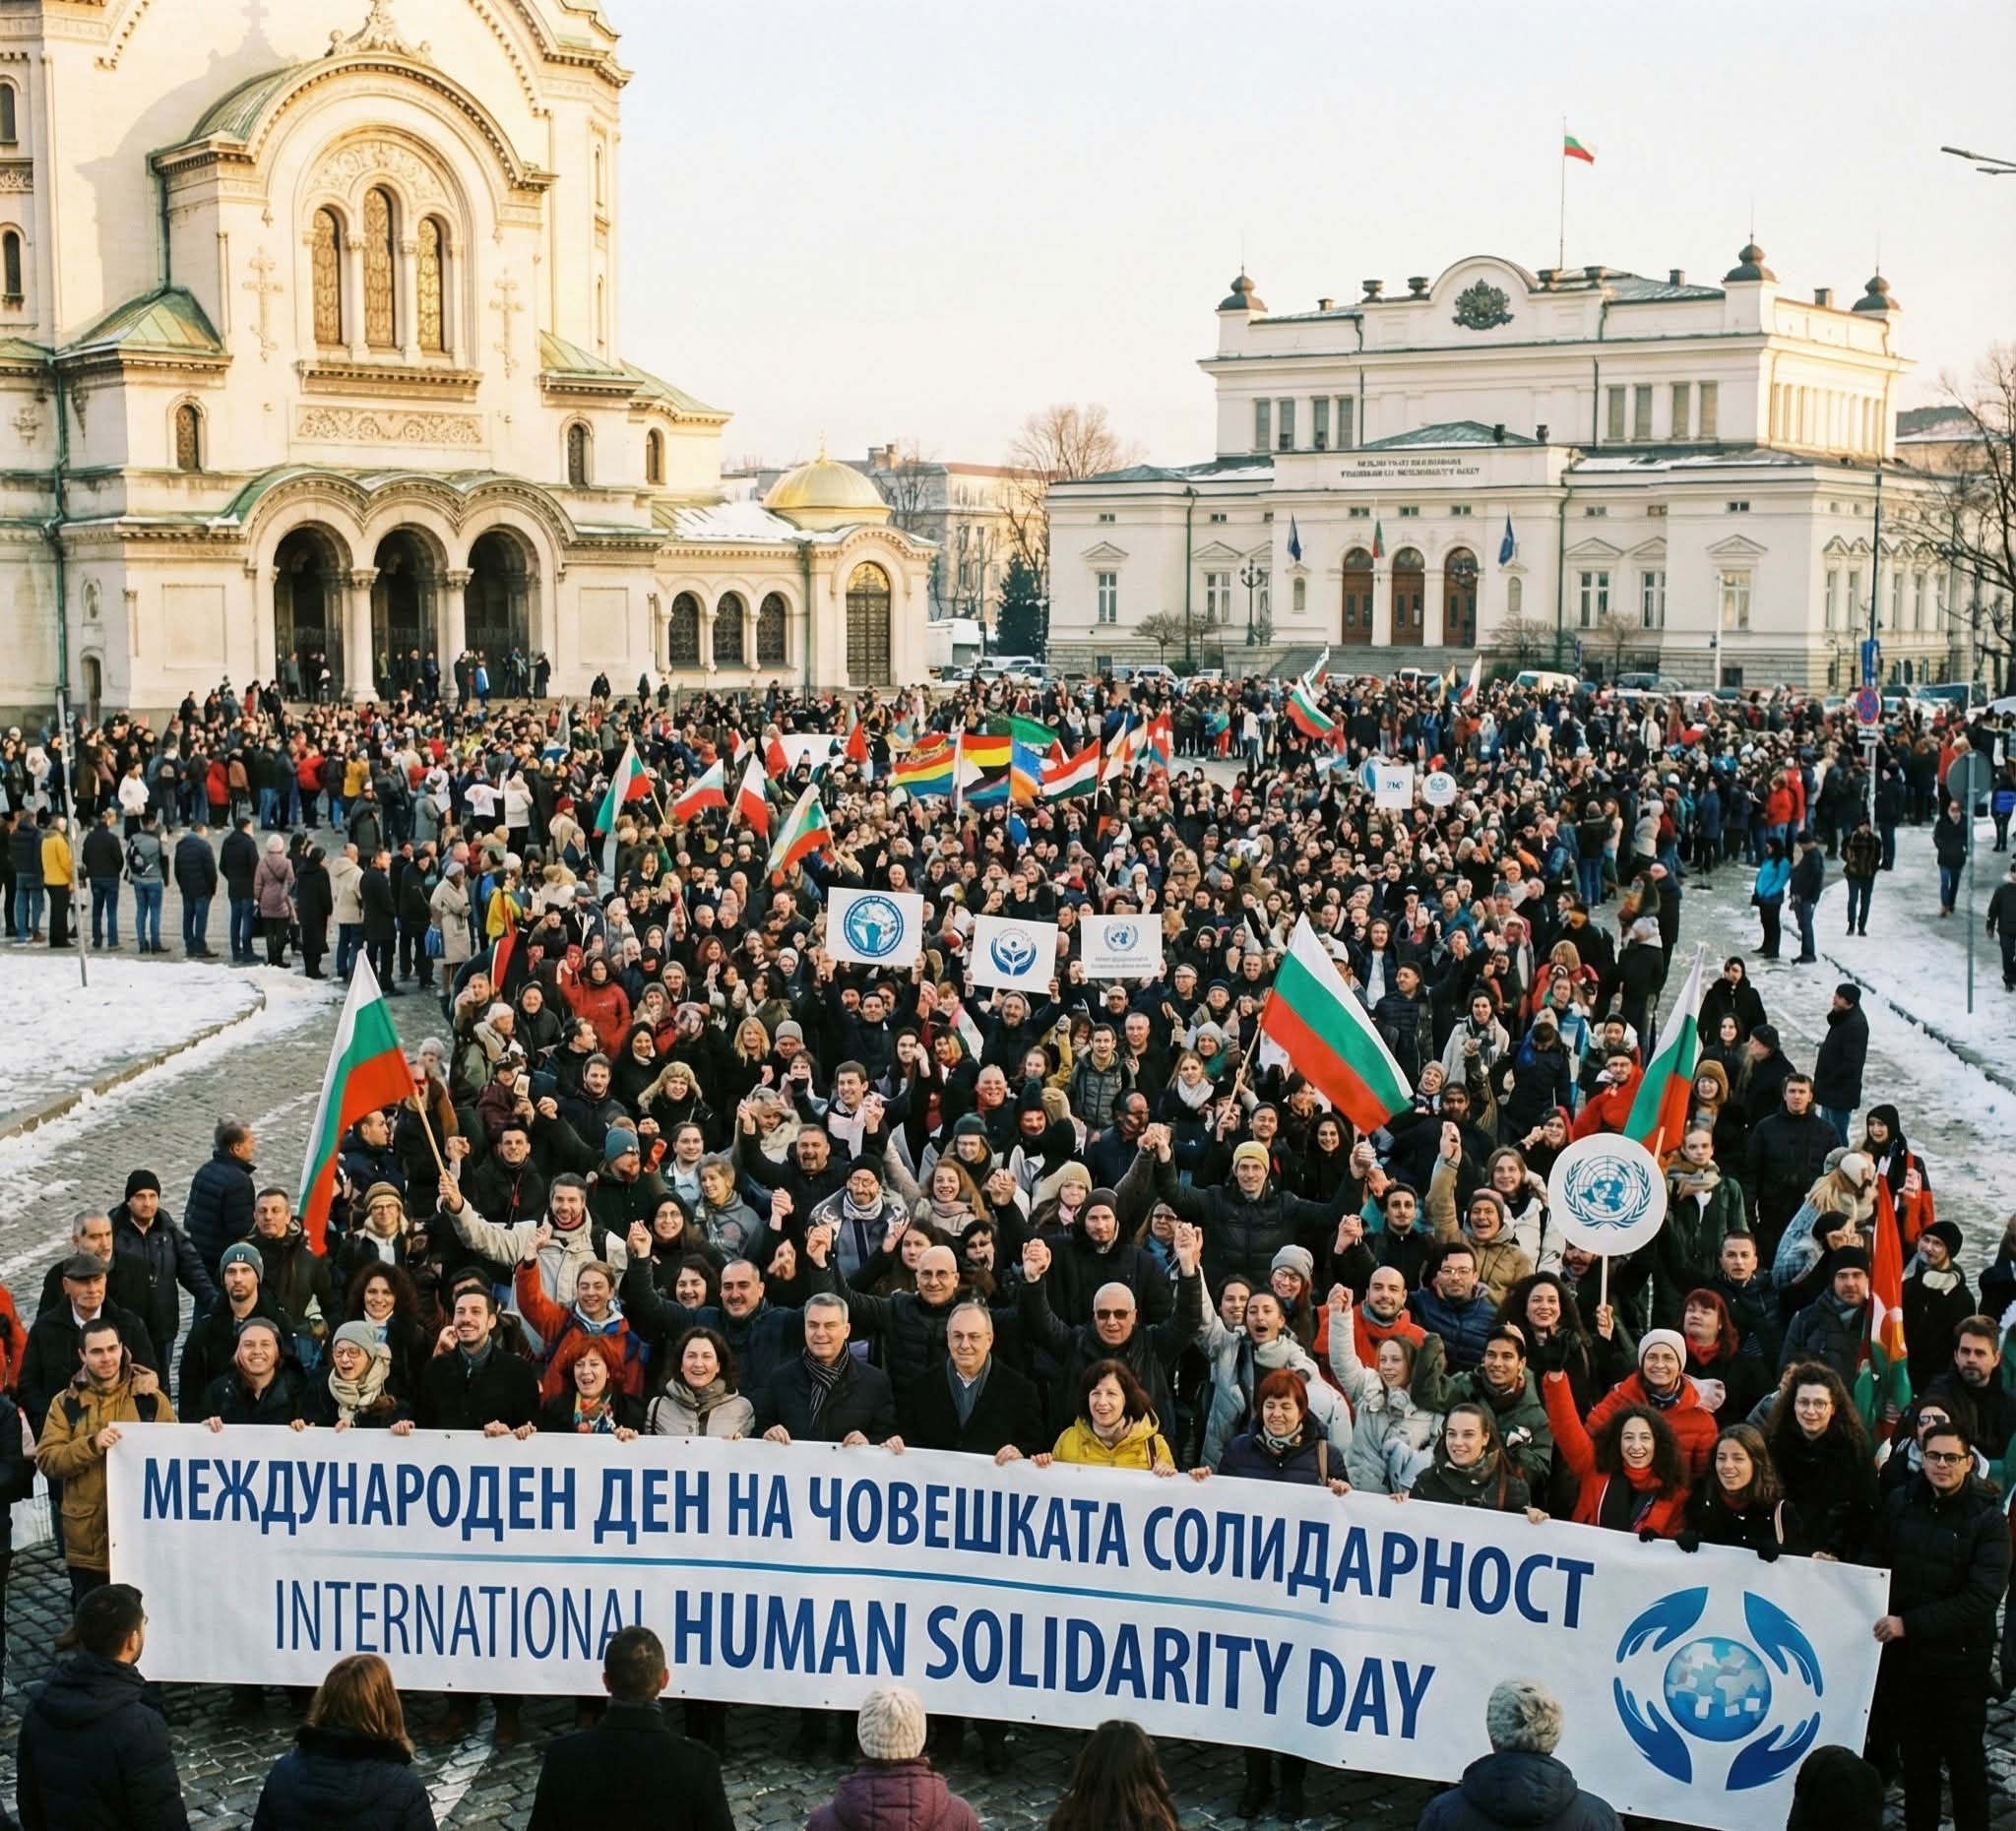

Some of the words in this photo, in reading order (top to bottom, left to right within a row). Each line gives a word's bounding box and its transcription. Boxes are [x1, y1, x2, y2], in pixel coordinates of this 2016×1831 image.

[143, 1457, 577, 1543] МЕЖДУНАРОДЕН
[594, 1468, 711, 1546] ДЕН
[727, 1472, 793, 1541] НА
[809, 1477, 1130, 1569] ЧОВЕШКАТА
[1143, 1504, 1596, 1630] СОЛИДАРНОСТ
[674, 1589, 908, 1677] HUMAN
[924, 1604, 1294, 1717] SOLIDARITY
[1304, 1647, 1436, 1740] DAY
